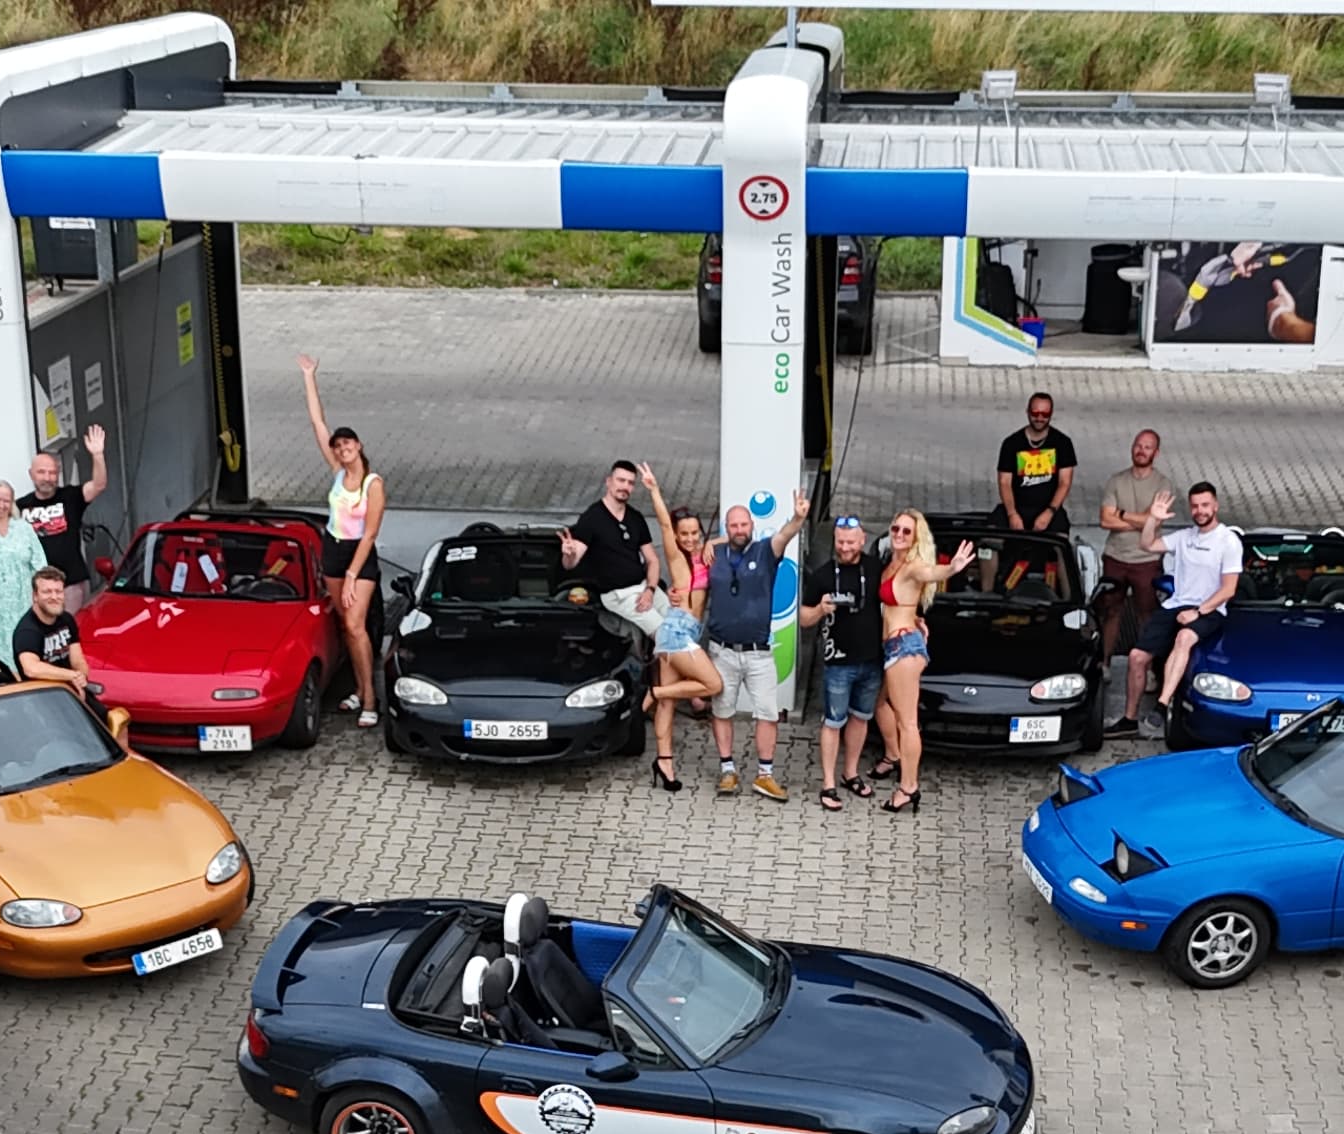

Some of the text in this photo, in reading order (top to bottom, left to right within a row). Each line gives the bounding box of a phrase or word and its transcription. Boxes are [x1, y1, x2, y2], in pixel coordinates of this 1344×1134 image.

[750, 192, 778, 205] 2.75
[770, 232, 792, 394] eco Car Wash
[148, 948, 172, 967] 1BC
